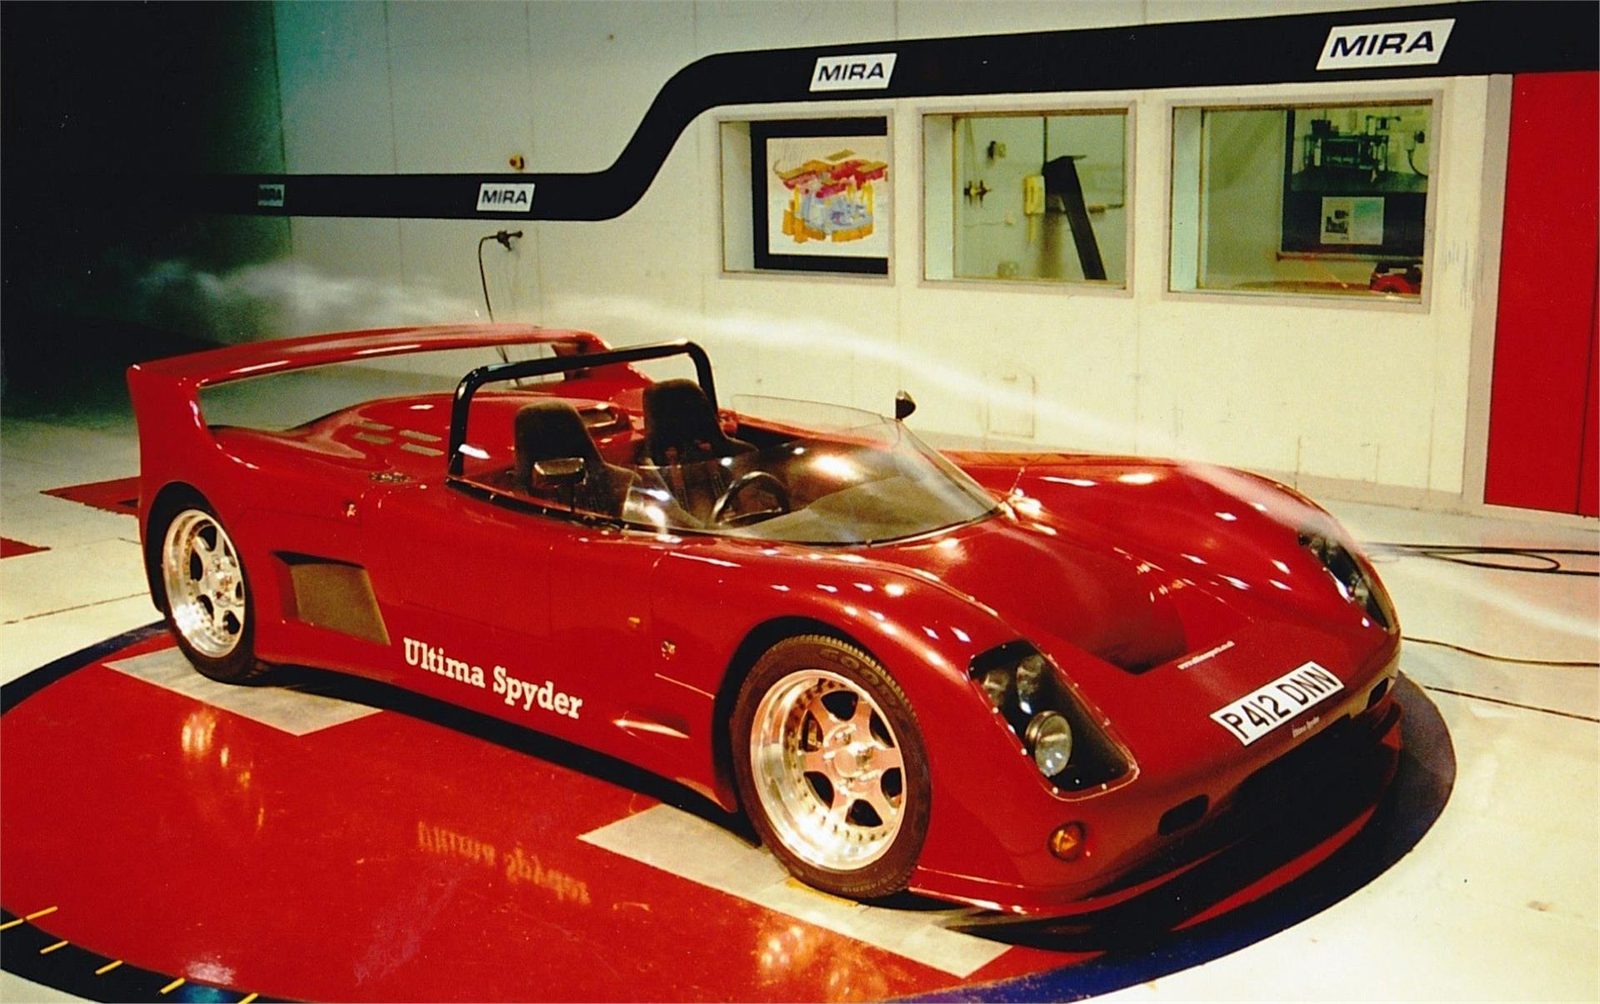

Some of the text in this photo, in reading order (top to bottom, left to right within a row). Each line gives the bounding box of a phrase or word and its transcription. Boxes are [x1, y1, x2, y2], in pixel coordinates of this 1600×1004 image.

[1330, 31, 1433, 57] MIRA
[818, 62, 884, 81] MIRA
[482, 190, 527, 204] MIRA
[403, 637, 583, 719] Ultima Spyder
[1221, 695, 1292, 739] P412
[1276, 666, 1338, 706] DNN
